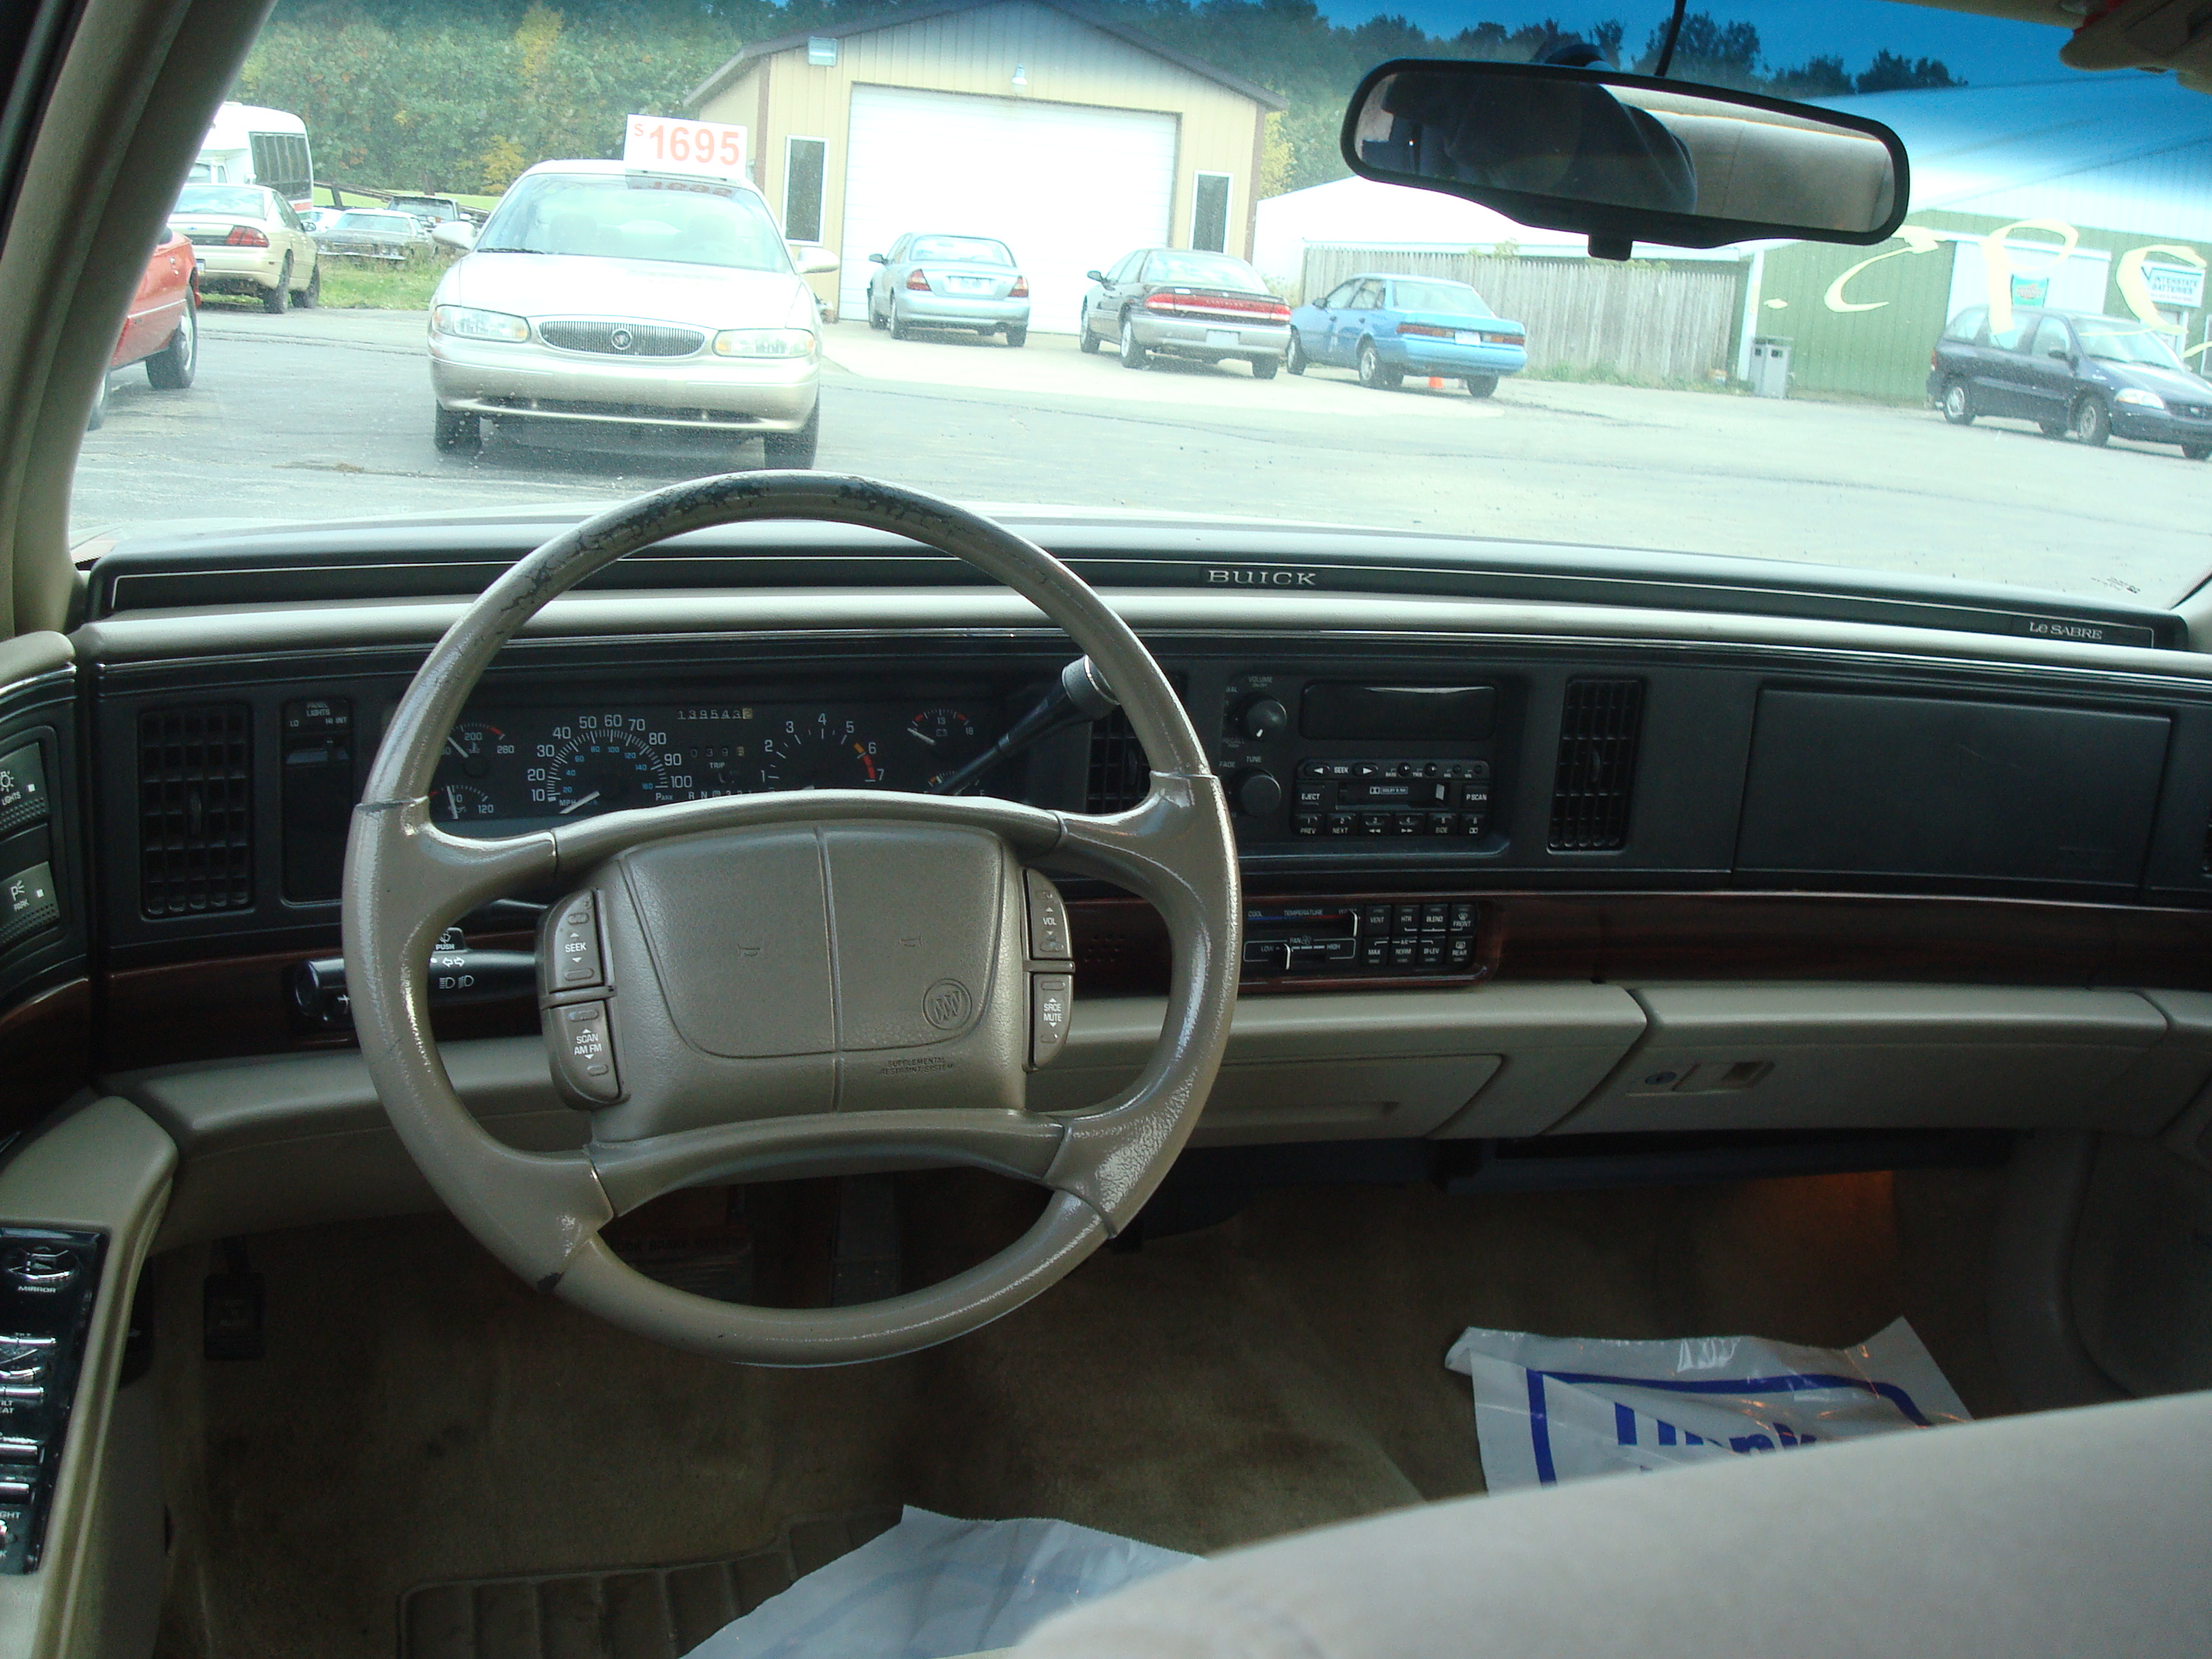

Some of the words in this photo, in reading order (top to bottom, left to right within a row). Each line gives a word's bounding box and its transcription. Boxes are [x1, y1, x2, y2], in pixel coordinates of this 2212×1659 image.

[649, 125, 739, 166] 1695
[1208, 570, 1317, 585] BUICK
[579, 716, 597, 729] 50
[603, 714, 622, 727] 60
[627, 719, 646, 732] 70
[818, 713, 827, 726] 4
[552, 727, 572, 740] 40
[786, 721, 794, 733] 3
[845, 721, 855, 734] 5
[464, 732, 482, 741] 200
[649, 732, 667, 745] 80
[536, 744, 555, 757] 30
[764, 739, 773, 752] 2
[868, 742, 877, 754] 6
[664, 753, 682, 766] 90
[527, 768, 546, 782] 20
[761, 770, 766, 783] 1
[876, 768, 885, 781] 7
[670, 775, 692, 788] 100
[1, 791, 22, 806] LIGHTS
[531, 789, 545, 802] 10
[478, 804, 495, 814] 120
[1043, 917, 1057, 926] VOL
[565, 943, 587, 953] SEEK
[1043, 1012, 1062, 1022] MUTE
[576, 1033, 599, 1044] SCAN
